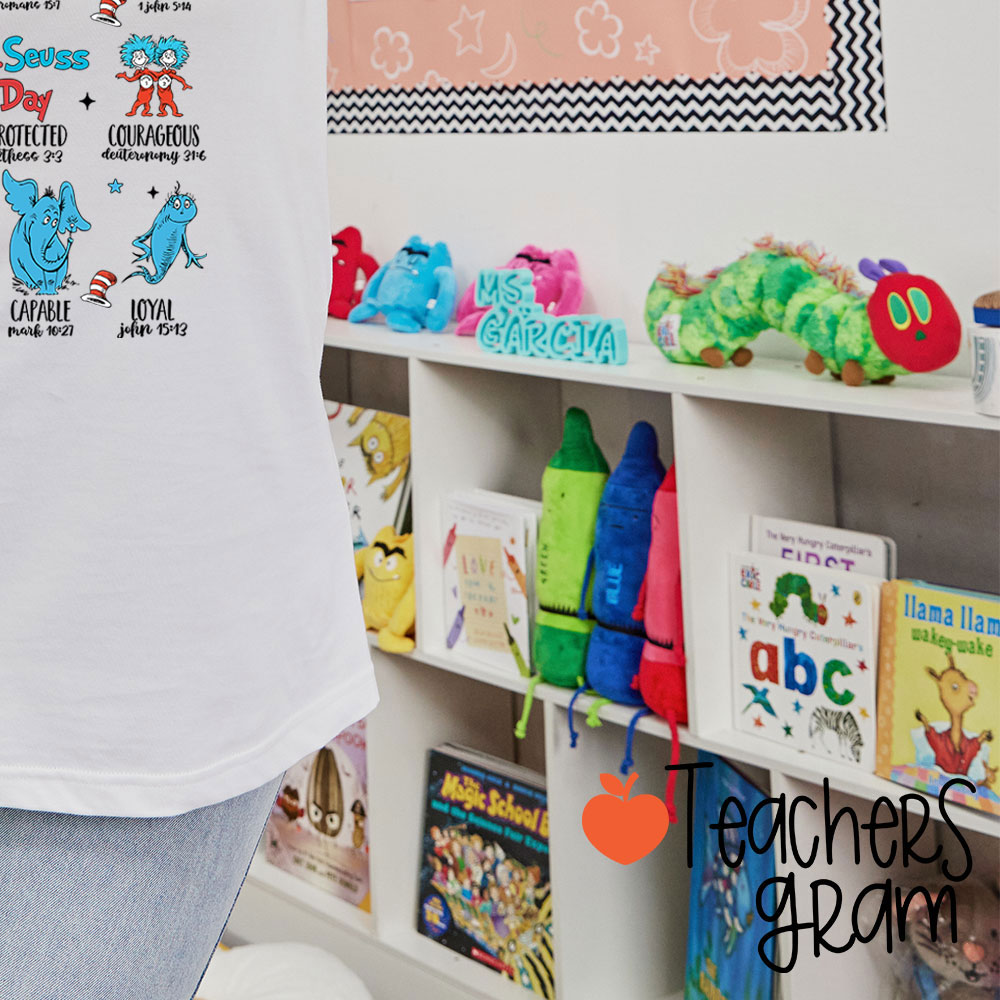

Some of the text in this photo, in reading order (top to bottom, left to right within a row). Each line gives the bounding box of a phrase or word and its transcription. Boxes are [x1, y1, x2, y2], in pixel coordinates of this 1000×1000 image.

[109, 124, 199, 147] COURAGEOUS
[42, 149, 64, 163] 3:3
[101, 149, 208, 164] deuteronomy 31:6
[11, 300, 70, 322] CAPABLE
[132, 299, 174, 323] LOYAL
[6, 321, 75, 338] mark 10:27
[117, 318, 189, 339] john 15:13
[478, 313, 623, 364] GARCIA
[605, 561, 625, 604] BLUE
[904, 593, 1000, 638] llama llam
[911, 626, 994, 658] wakey-wake
[750, 637, 856, 706] abc
[487, 788, 541, 833] School
